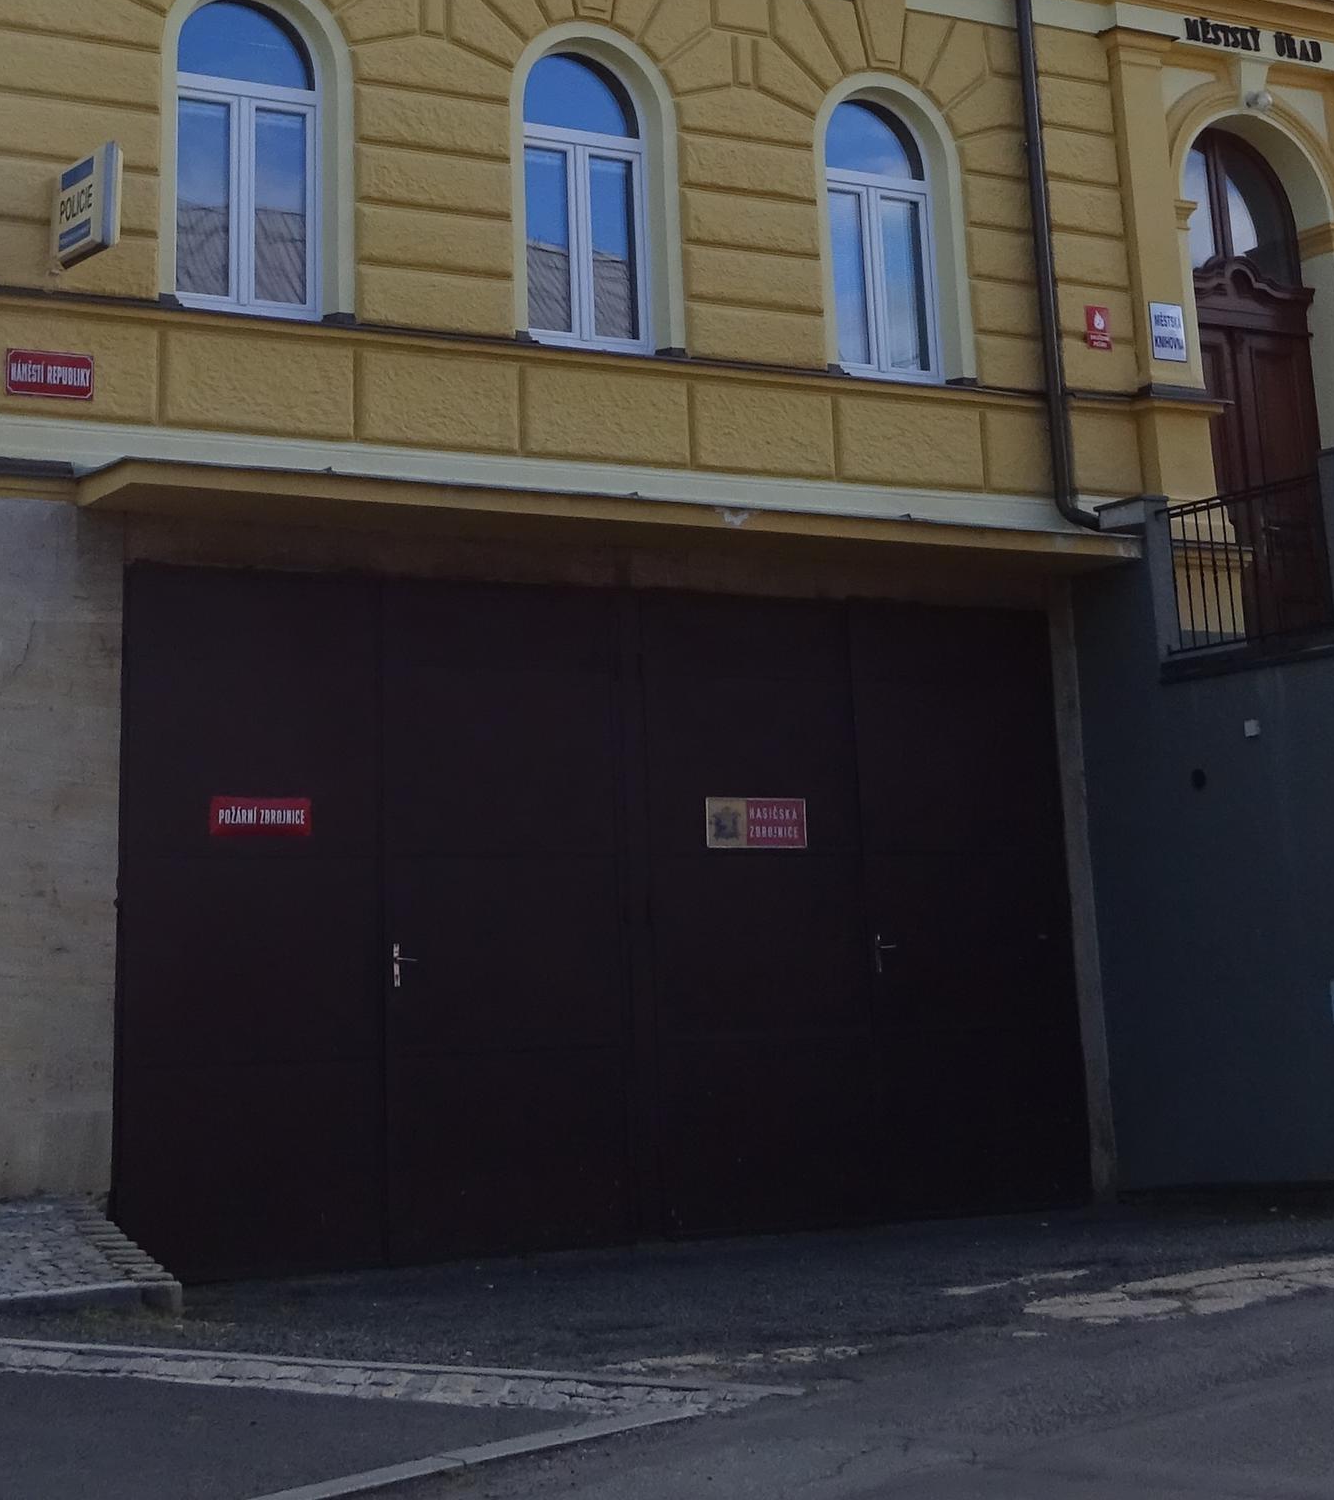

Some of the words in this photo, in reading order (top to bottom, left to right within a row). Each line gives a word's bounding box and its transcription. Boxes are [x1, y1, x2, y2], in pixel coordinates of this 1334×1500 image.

[1184, 17, 1261, 51] MĚSTSKÝ
[1274, 31, 1322, 63] ÚŘAD
[59, 183, 93, 224] POLICIE
[11, 359, 45, 383] NÁMĚSTÍ
[47, 365, 91, 387] REPUBLIKY
[218, 806, 257, 825] POŽÁRNÍ
[259, 809, 305, 825] ZBROJNICE
[749, 826, 799, 839] ZBROJNICE
